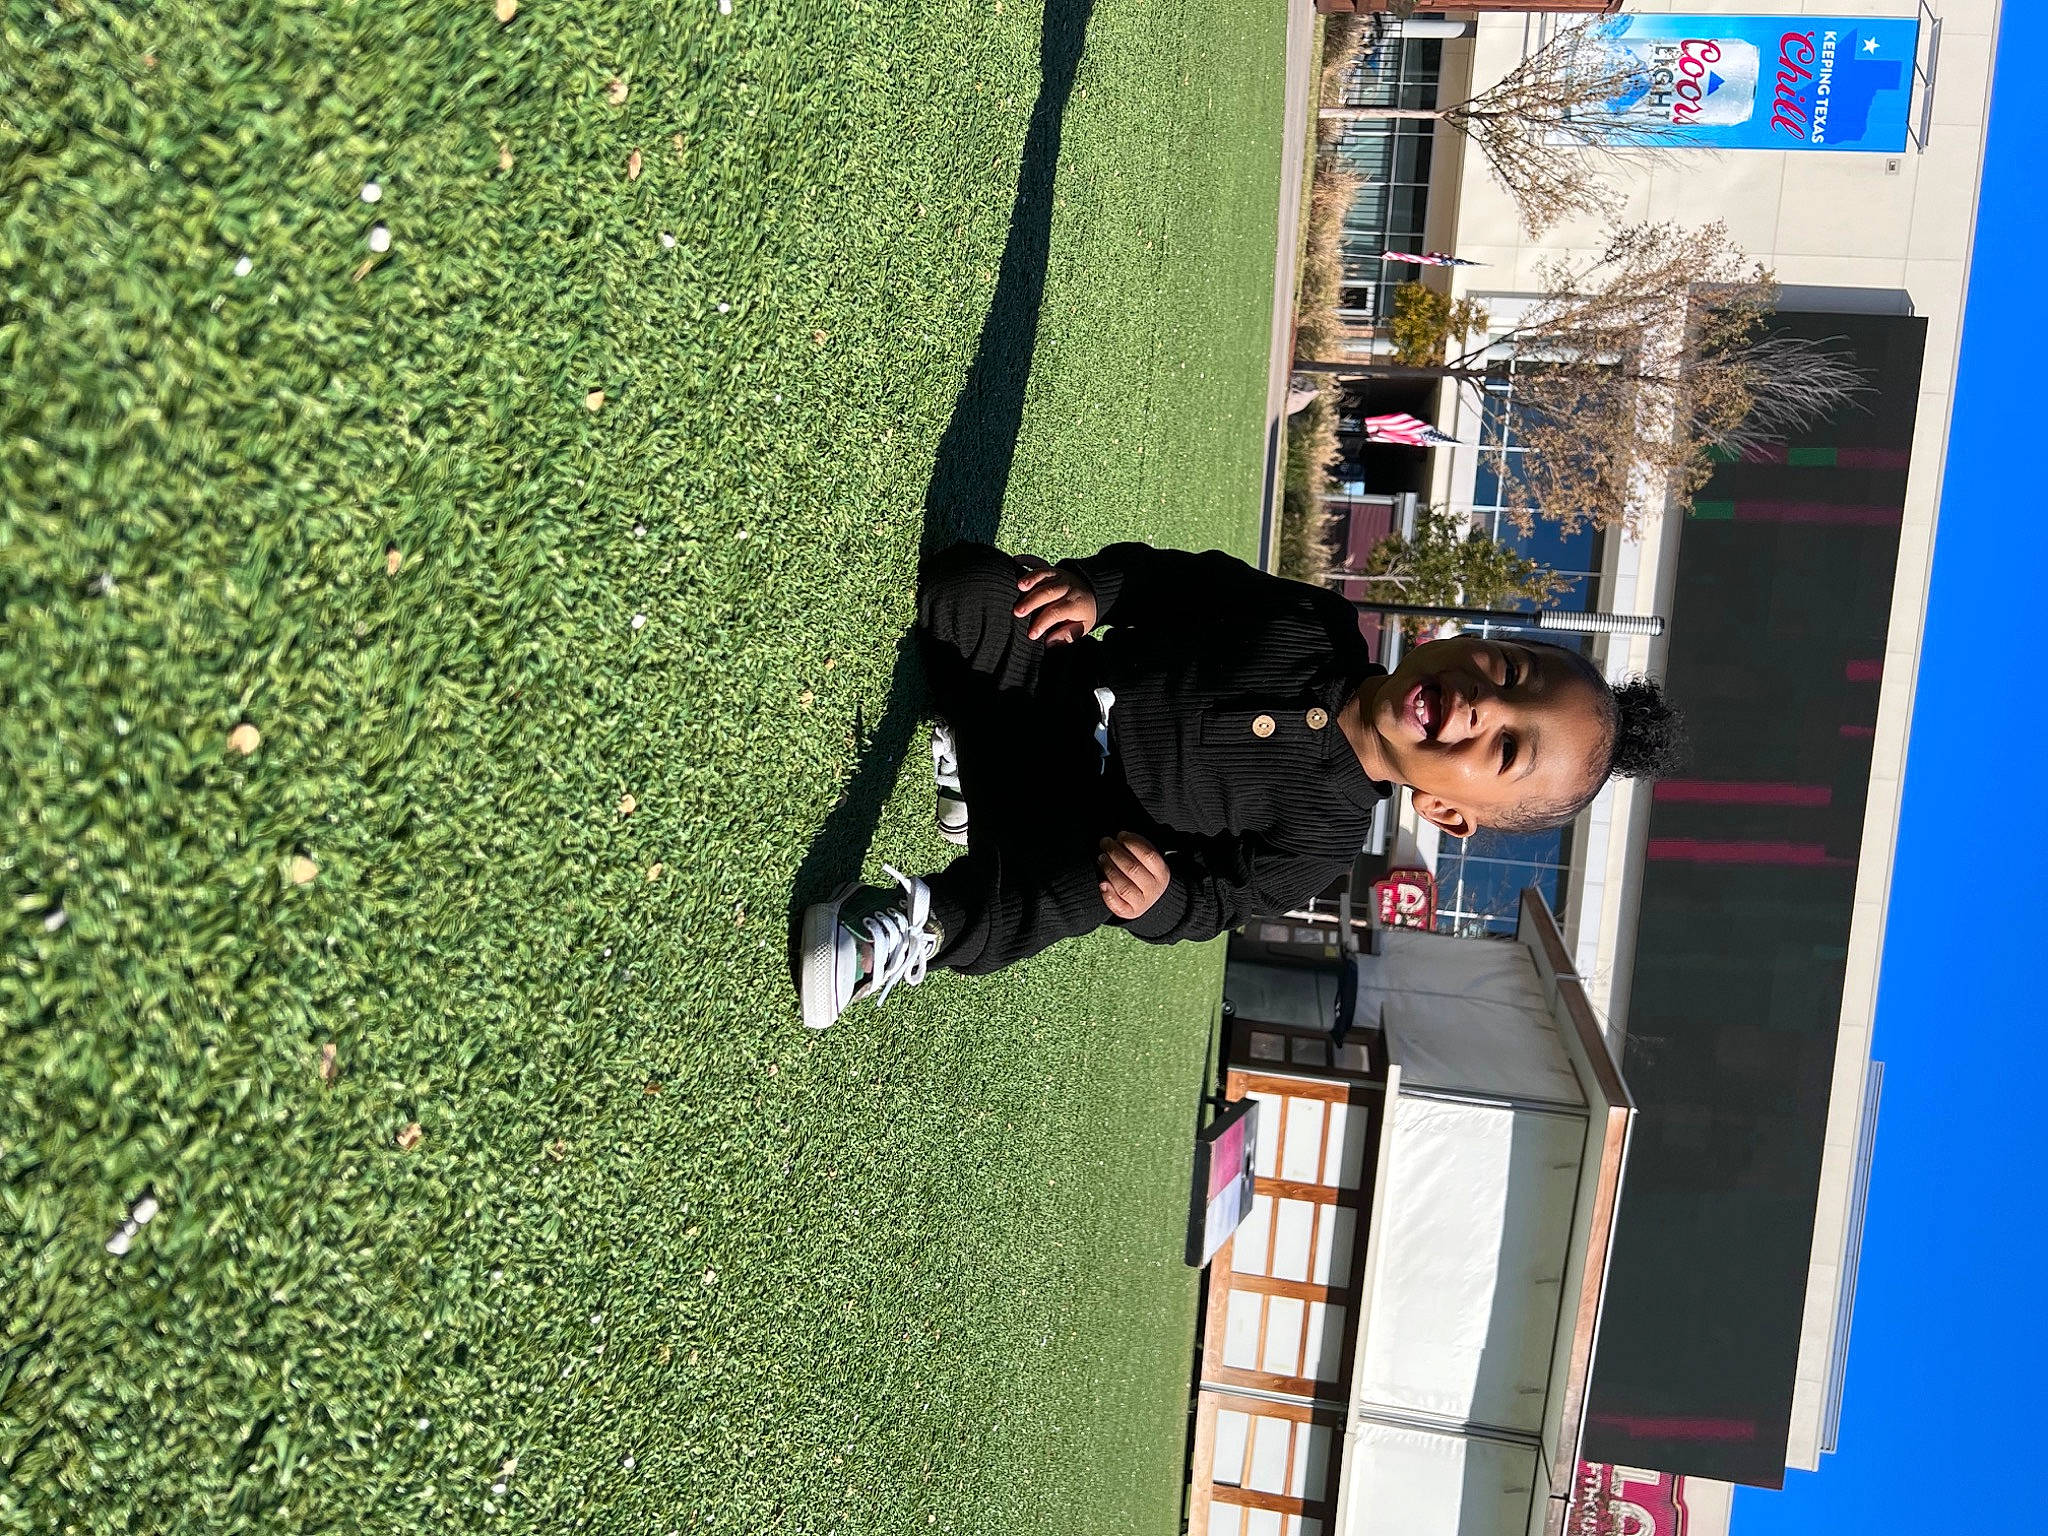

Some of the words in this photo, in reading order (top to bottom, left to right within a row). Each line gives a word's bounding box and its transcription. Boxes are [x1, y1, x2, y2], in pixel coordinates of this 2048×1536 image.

[1770, 31, 1816, 140] Chill
[1817, 31, 1837, 96] KEEPING
[1811, 97, 1829, 144] TEXAS
